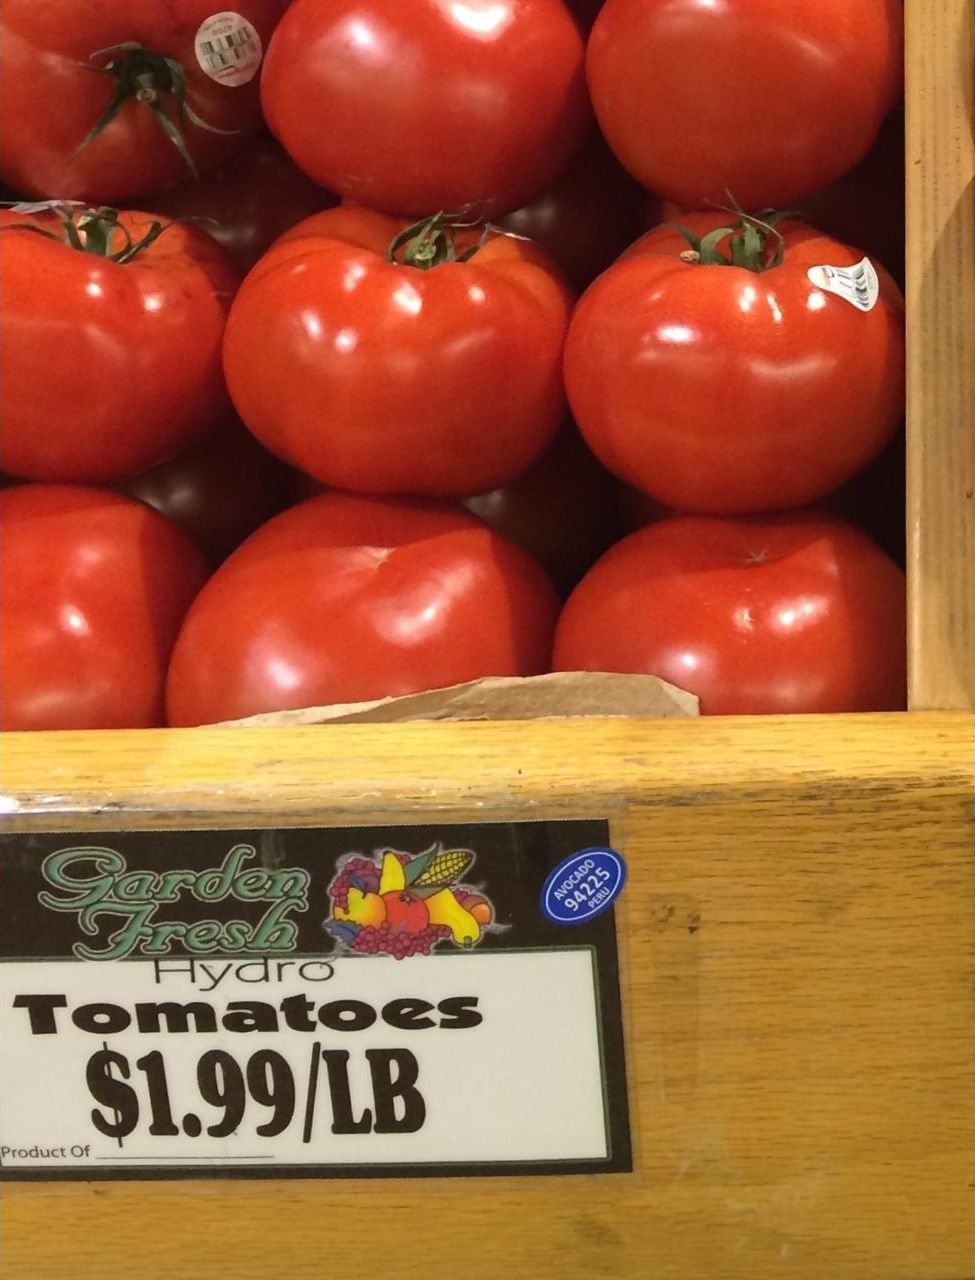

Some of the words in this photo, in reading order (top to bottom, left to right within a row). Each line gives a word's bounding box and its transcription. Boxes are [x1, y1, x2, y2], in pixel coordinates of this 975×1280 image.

[38, 844, 310, 912] Garden
[553, 859, 595, 901] AVOCADO
[564, 867, 610, 912] 94225
[587, 886, 610, 909] PERU
[72, 896, 309, 962] Fresh
[154, 958, 335, 992] Hydro
[13, 993, 484, 1034] Tomatoes
[86, 1041, 426, 1148] $1.99/LB
[1, 1145, 65, 1159] Product
[71, 1144, 91, 1158] Of
